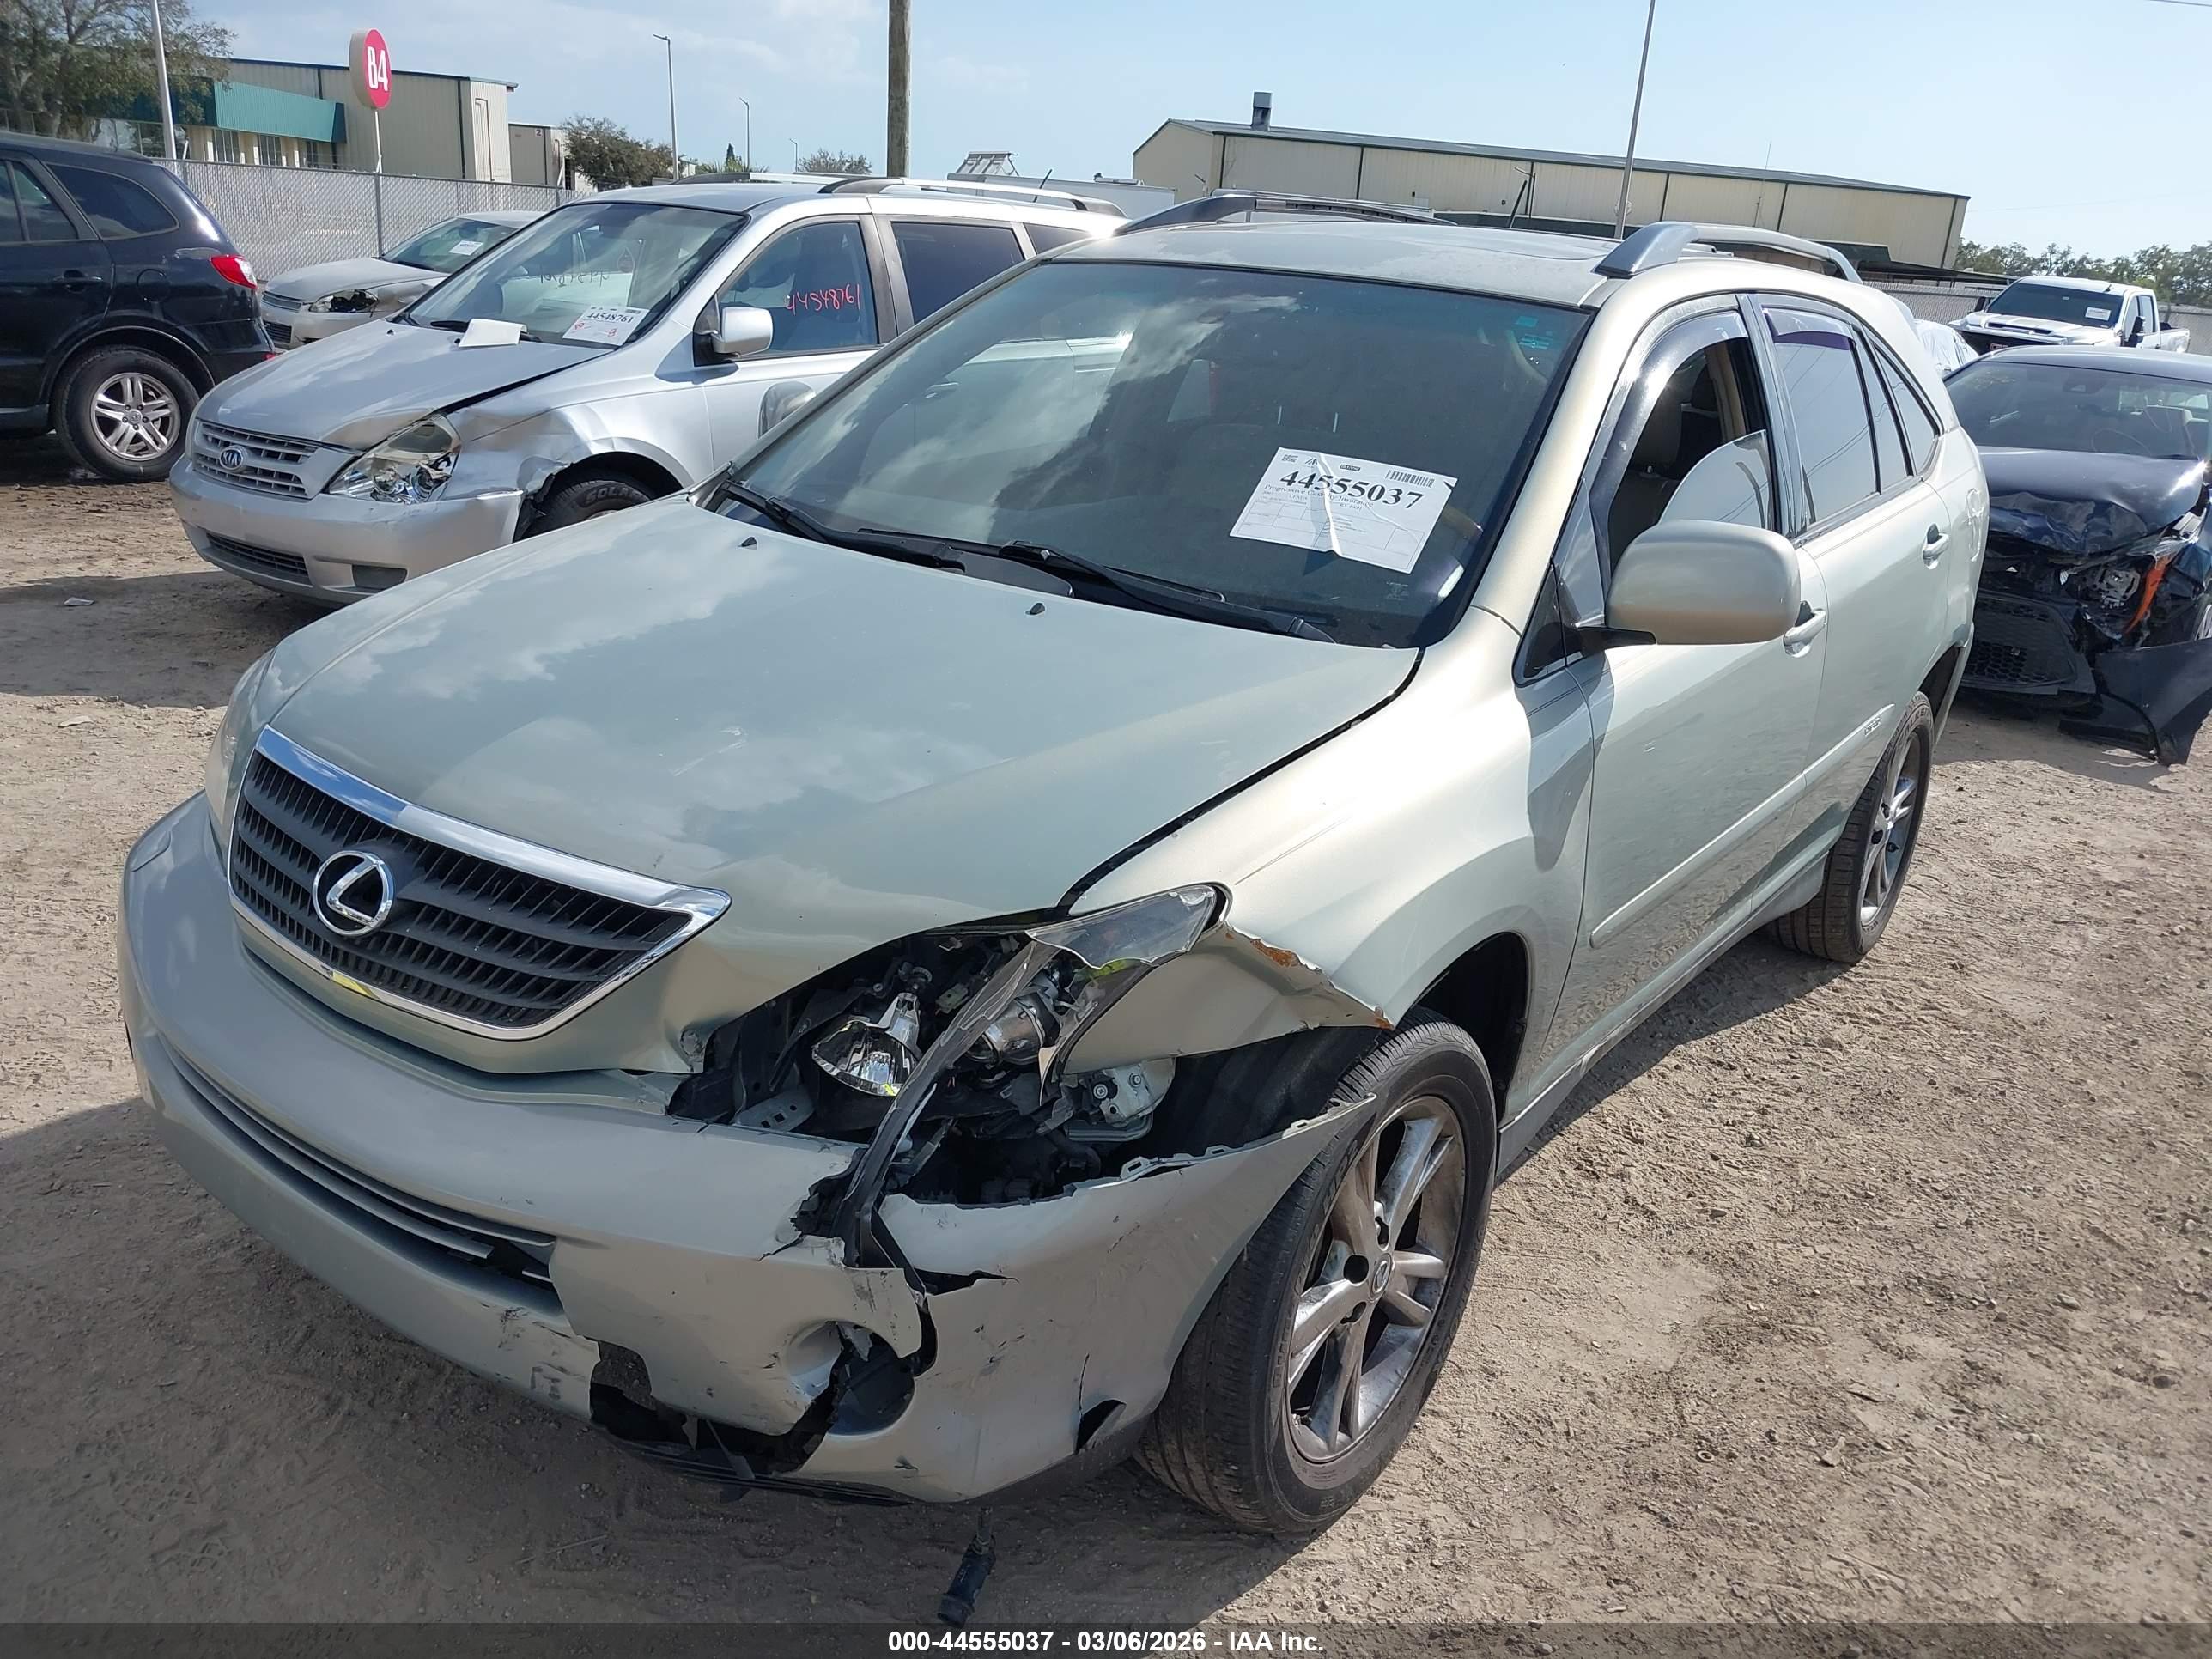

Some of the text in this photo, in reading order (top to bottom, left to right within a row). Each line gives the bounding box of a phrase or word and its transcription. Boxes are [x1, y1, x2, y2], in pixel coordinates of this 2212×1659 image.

[785, 283, 860, 316] 44548761
[586, 312, 634, 323] 44548761
[223, 451, 238, 466] KIA
[1280, 471, 1425, 509] 44555037
